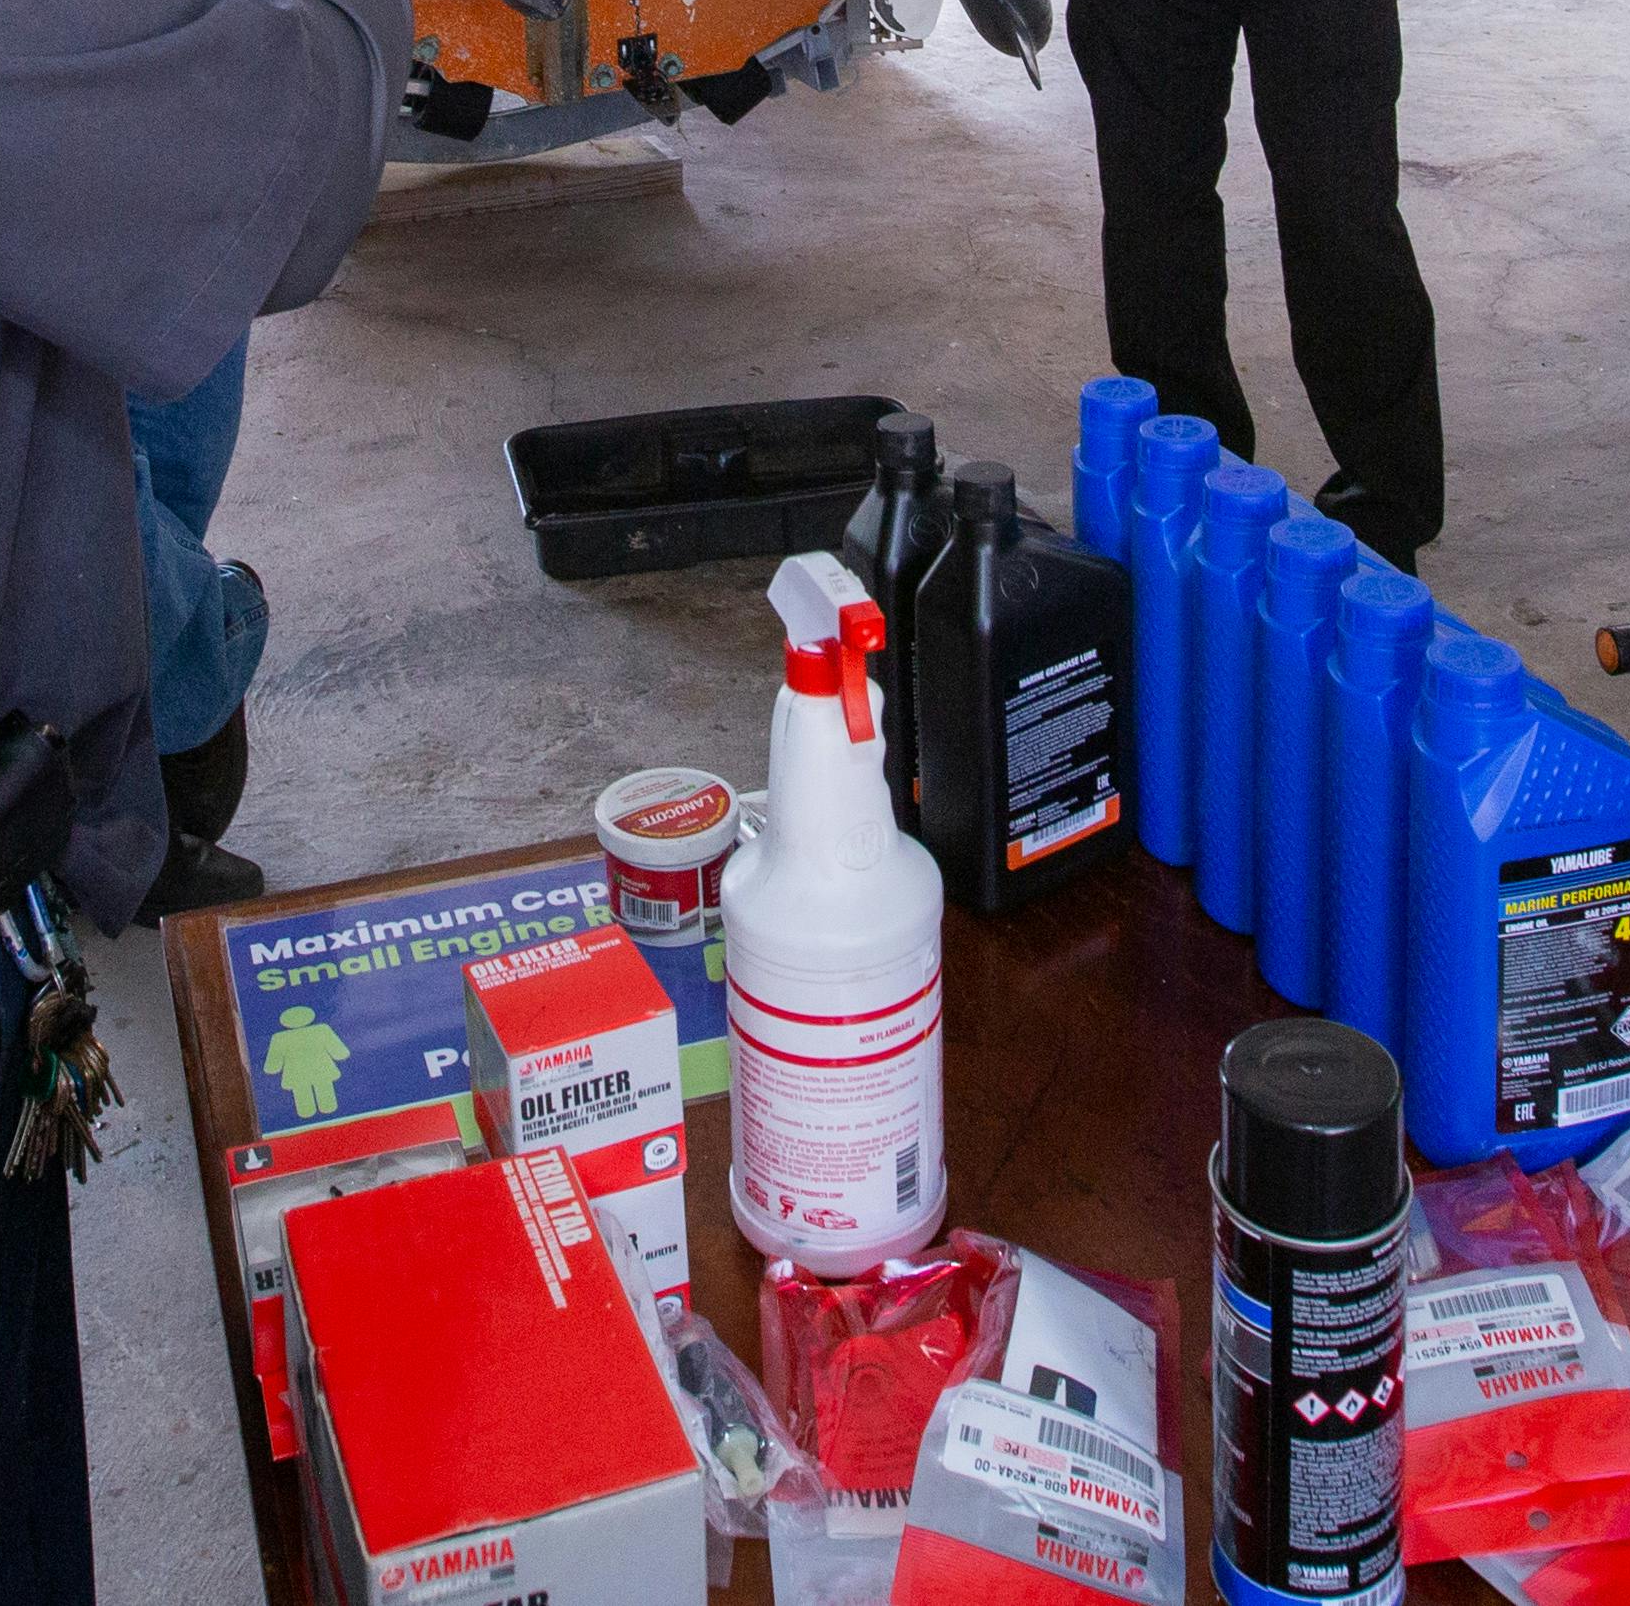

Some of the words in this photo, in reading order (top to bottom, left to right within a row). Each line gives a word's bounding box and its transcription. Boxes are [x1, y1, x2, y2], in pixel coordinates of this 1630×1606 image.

[638, 794, 714, 828] LANOCOTE
[1550, 848, 1613, 875] YAMALUBE
[1505, 896, 1558, 916] MARINE
[1585, 909, 1600, 919] SAE
[250, 901, 504, 965] Maximum
[1505, 920, 1534, 933] ENGINE
[1535, 918, 1549, 928] OIL
[256, 945, 403, 992] Small
[412, 914, 576, 964] Engine
[470, 959, 508, 979] OIL
[508, 938, 580, 968] FILTER
[859, 1034, 875, 1045] NON
[876, 1017, 915, 1041] FLAMMABLE
[535, 1044, 593, 1072] YAMAHA
[1513, 1053, 1550, 1067] YAMAHA
[520, 1092, 556, 1122] OIL
[561, 1070, 631, 1109] FILTER
[522, 1119, 547, 1133] FILTRE
[556, 1107, 578, 1123] HUILE
[585, 1098, 611, 1113] FILTRO
[613, 1094, 631, 1105] OLIO
[523, 1128, 550, 1142] FILTRO
[551, 1124, 561, 1135] DE
[562, 1116, 590, 1131] ACEITE
[527, 1149, 575, 1204] TRIM
[548, 1201, 592, 1246] TAB
[1481, 1325, 1556, 1349] YAMAHA
[1477, 1366, 1564, 1399] YAMAHA
[1003, 1442, 1019, 1457] PC
[1069, 1477, 1141, 1519] YAMAHA
[410, 1536, 514, 1584] YAMAHA
[1036, 1536, 1120, 1585] YAMAHA
[1302, 1565, 1349, 1579] YAMAHA
